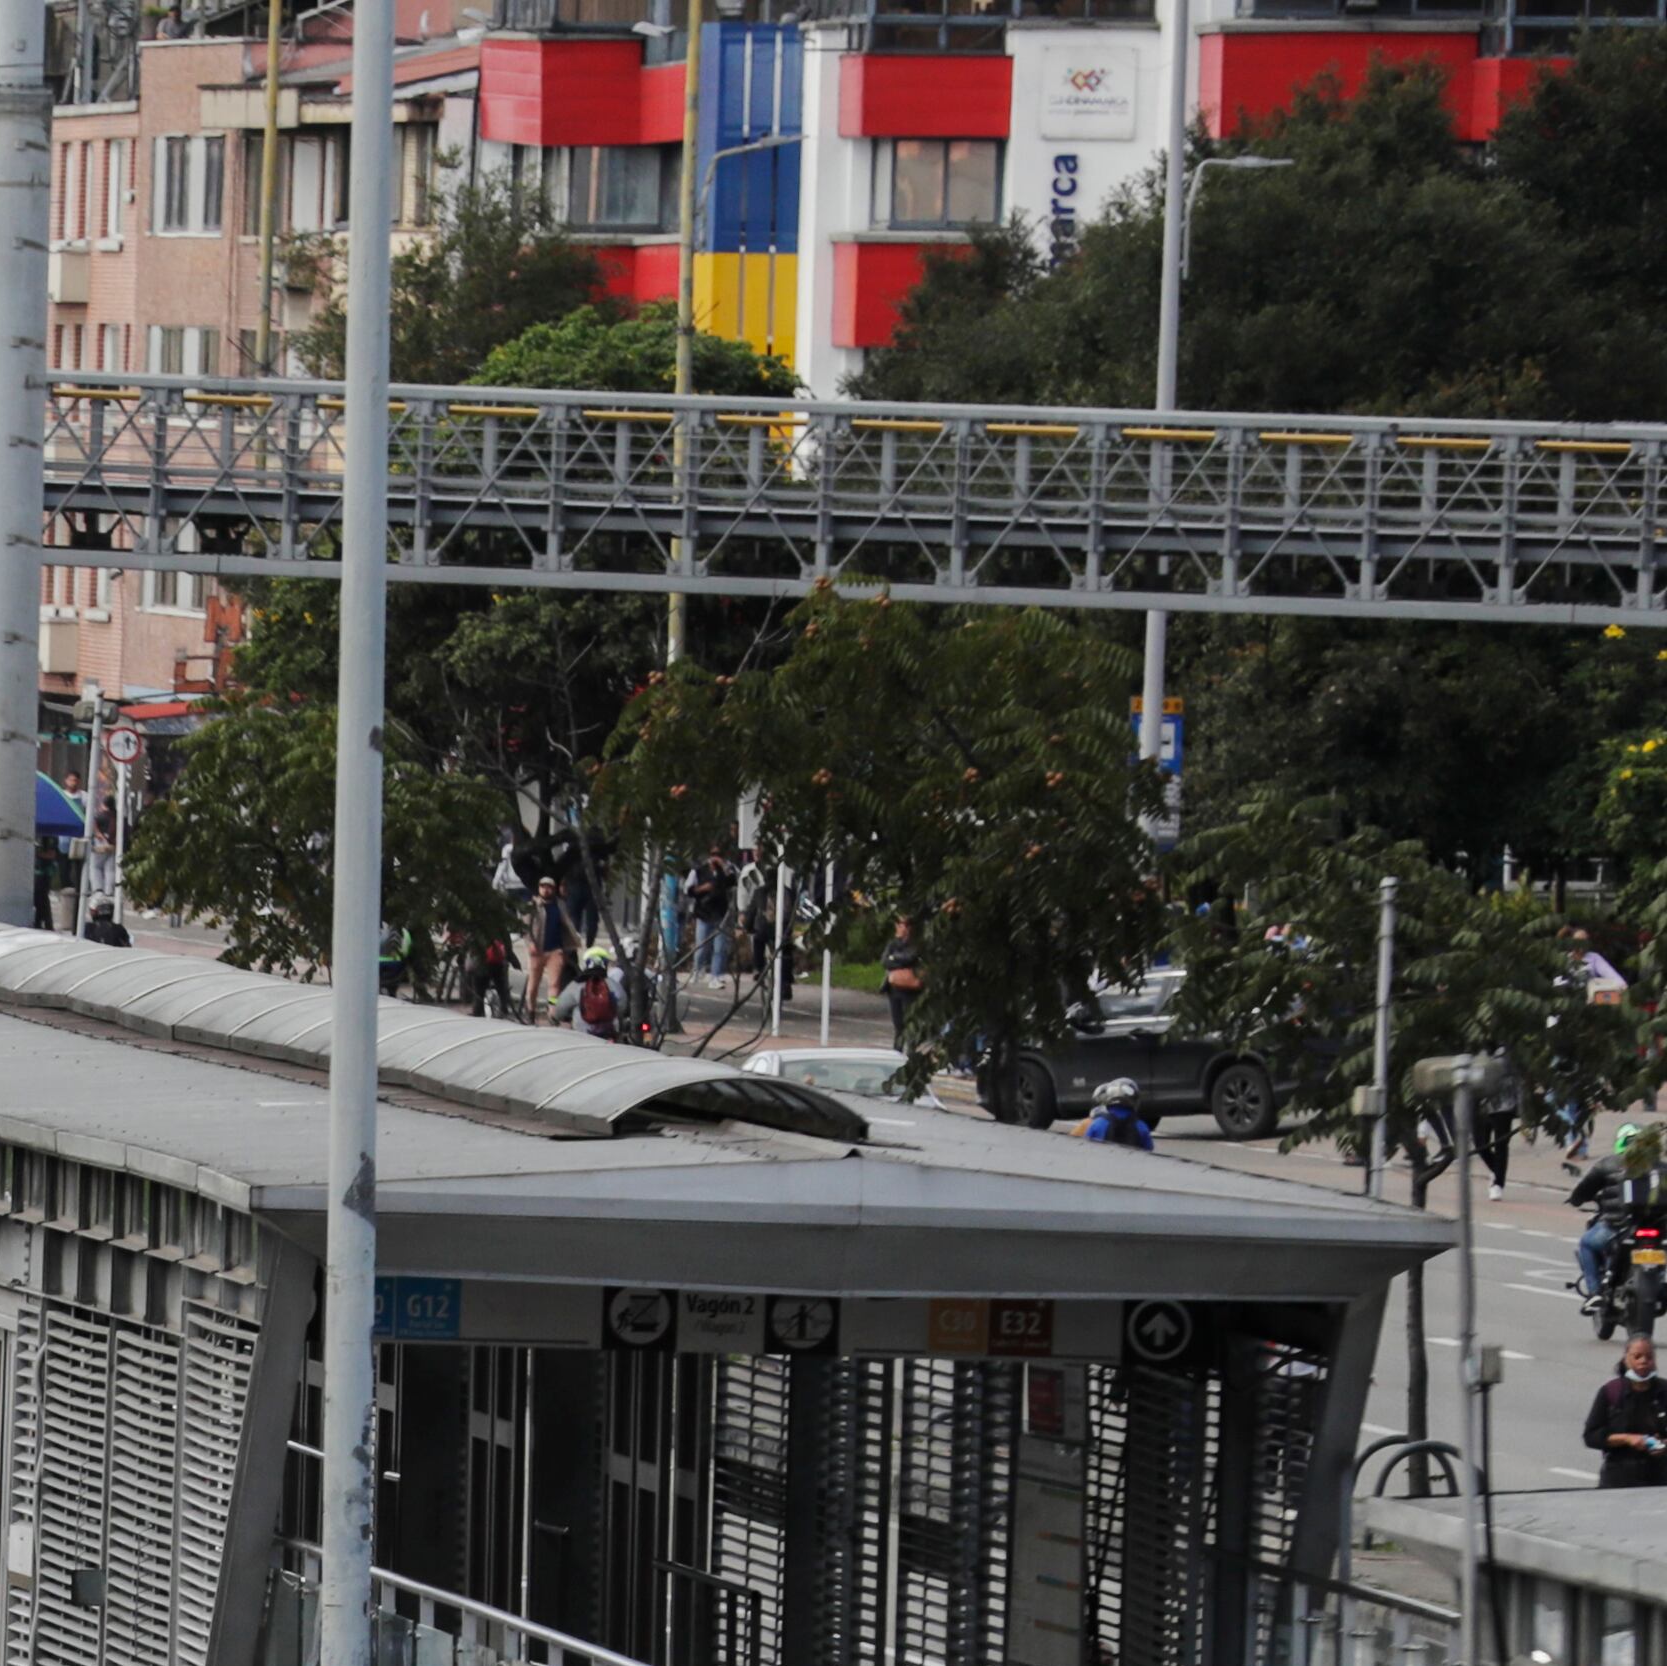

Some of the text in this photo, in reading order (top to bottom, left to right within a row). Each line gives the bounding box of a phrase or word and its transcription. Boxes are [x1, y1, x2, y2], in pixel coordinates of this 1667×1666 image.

[407, 1294, 450, 1318] G12
[685, 1294, 756, 1318] Vagón 2
[1002, 1308, 1042, 1335] E32
